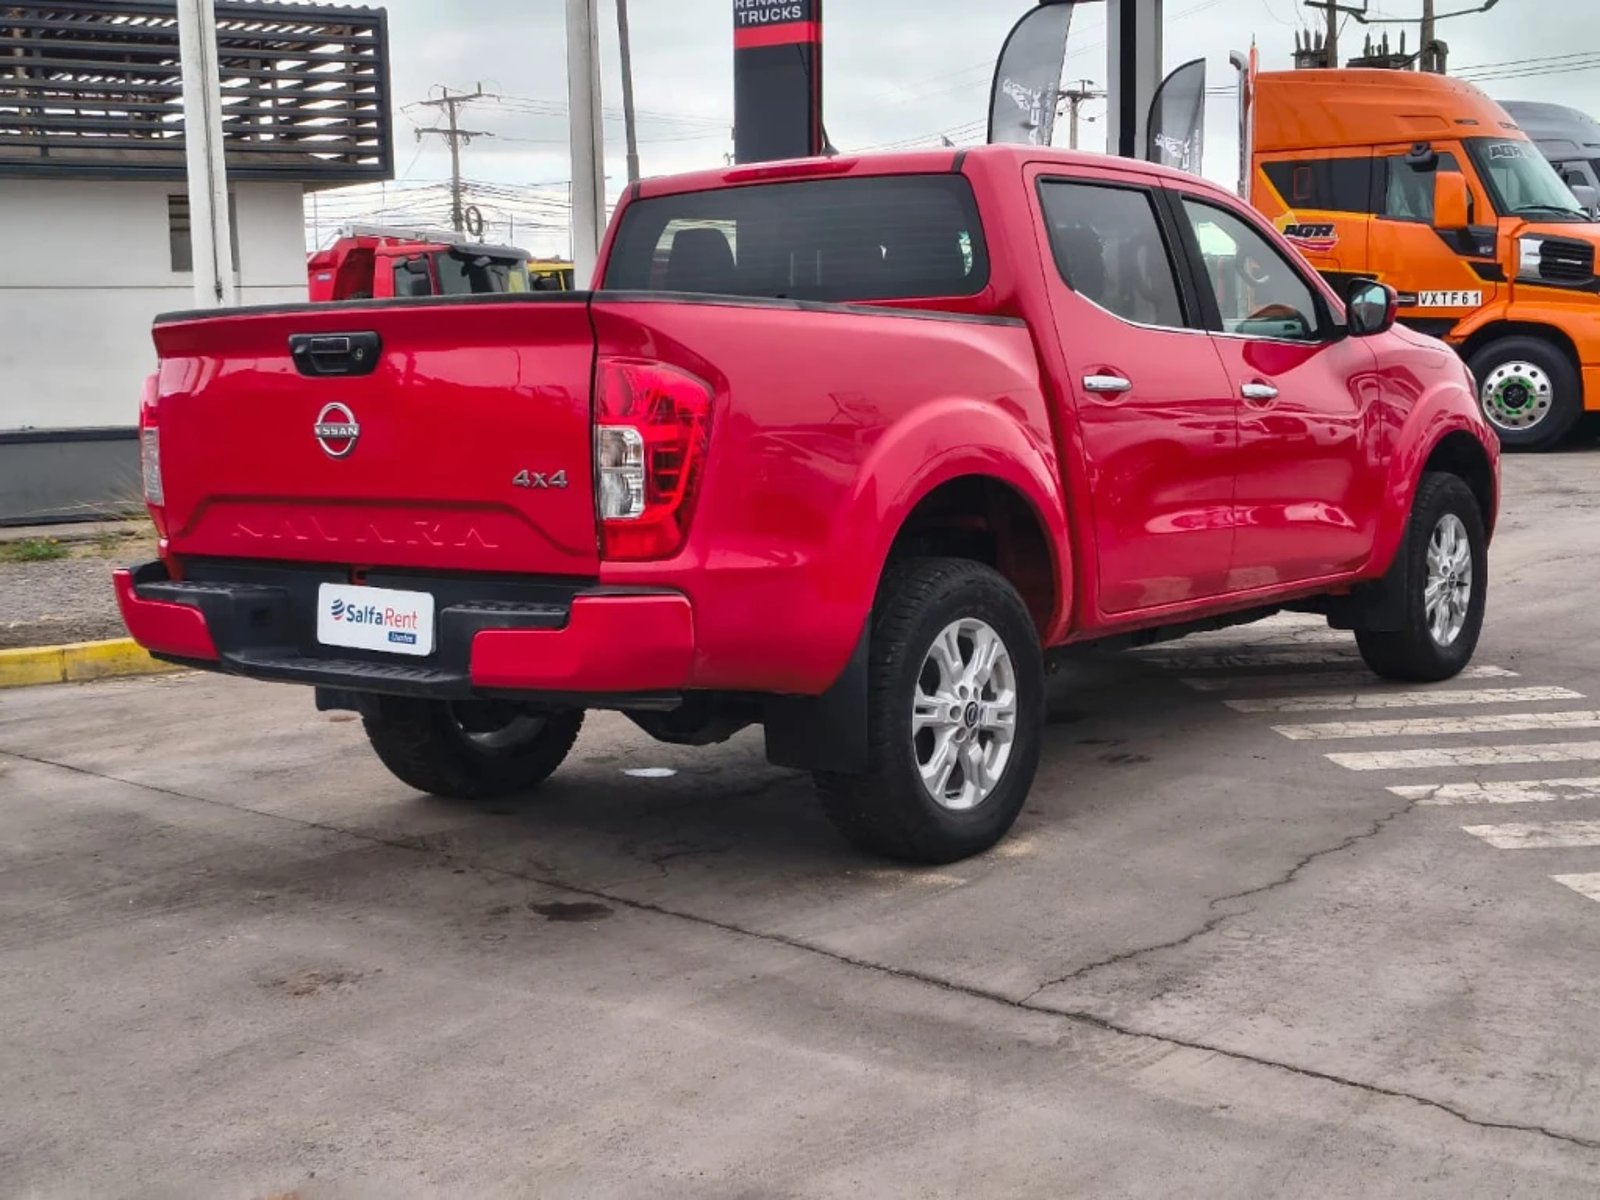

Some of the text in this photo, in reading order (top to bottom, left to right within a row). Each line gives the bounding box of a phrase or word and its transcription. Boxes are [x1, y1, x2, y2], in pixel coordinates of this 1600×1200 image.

[739, 5, 802, 24] TRUCKS
[1282, 223, 1336, 238] AGR
[1420, 292, 1479, 305] VXTF61
[512, 469, 568, 488] 4x4
[231, 515, 499, 549] NAVARA
[346, 603, 418, 630] SalfaRent
